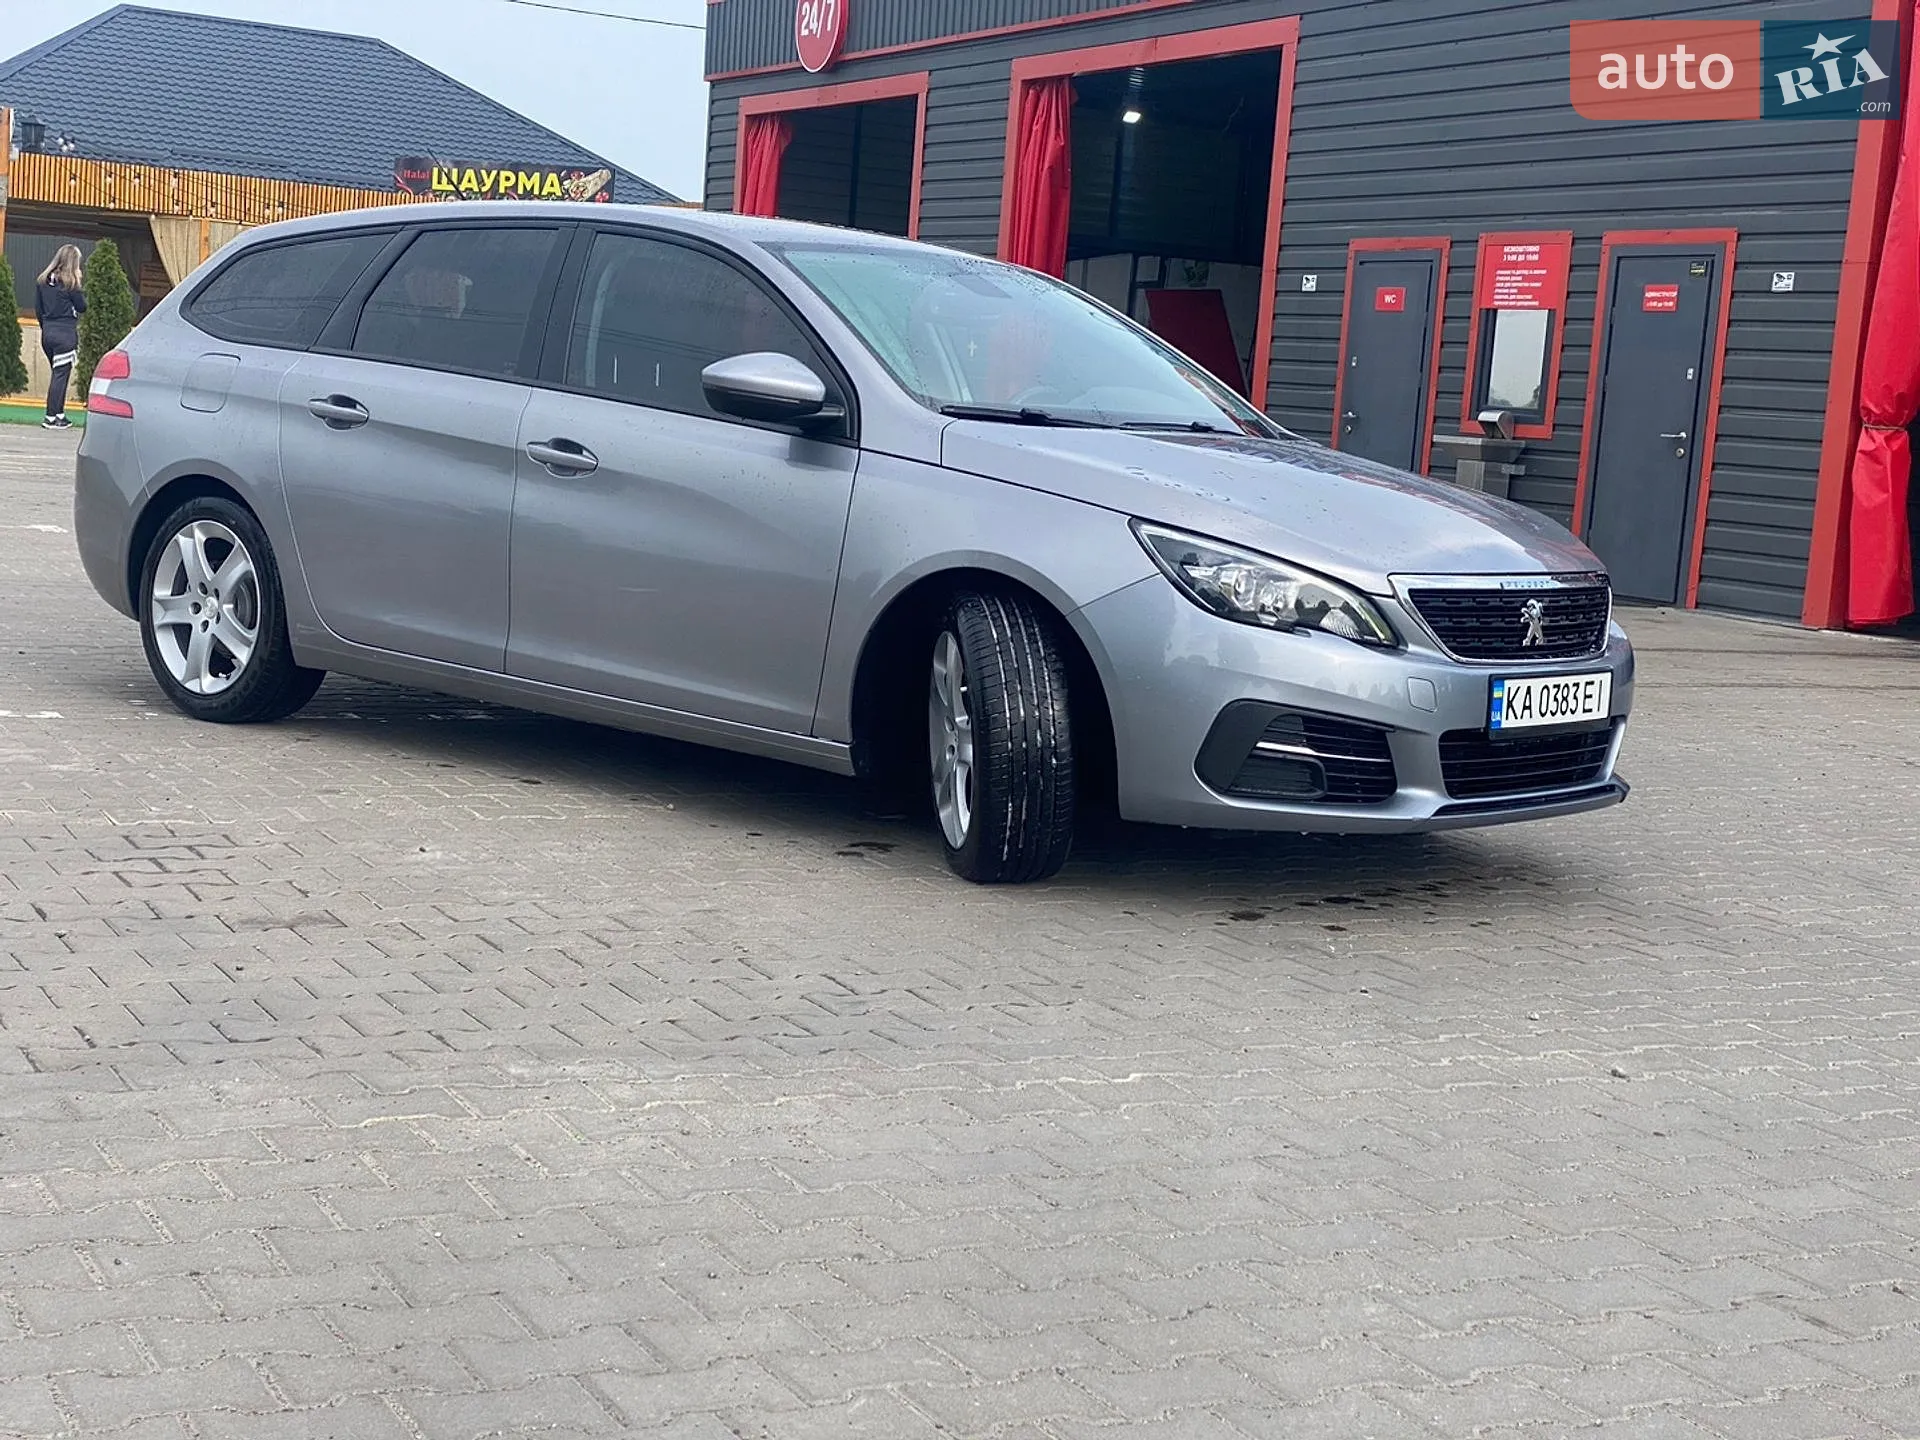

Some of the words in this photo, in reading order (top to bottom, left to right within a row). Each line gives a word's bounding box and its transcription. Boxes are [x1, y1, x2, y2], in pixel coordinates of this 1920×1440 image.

[800, 0, 835, 39] 24/7
[403, 169, 430, 181] Halal
[431, 166, 563, 197] ШАУРМА
[1384, 294, 1397, 304] WC
[1505, 685, 1533, 721] KA
[1538, 681, 1580, 718] 0383
